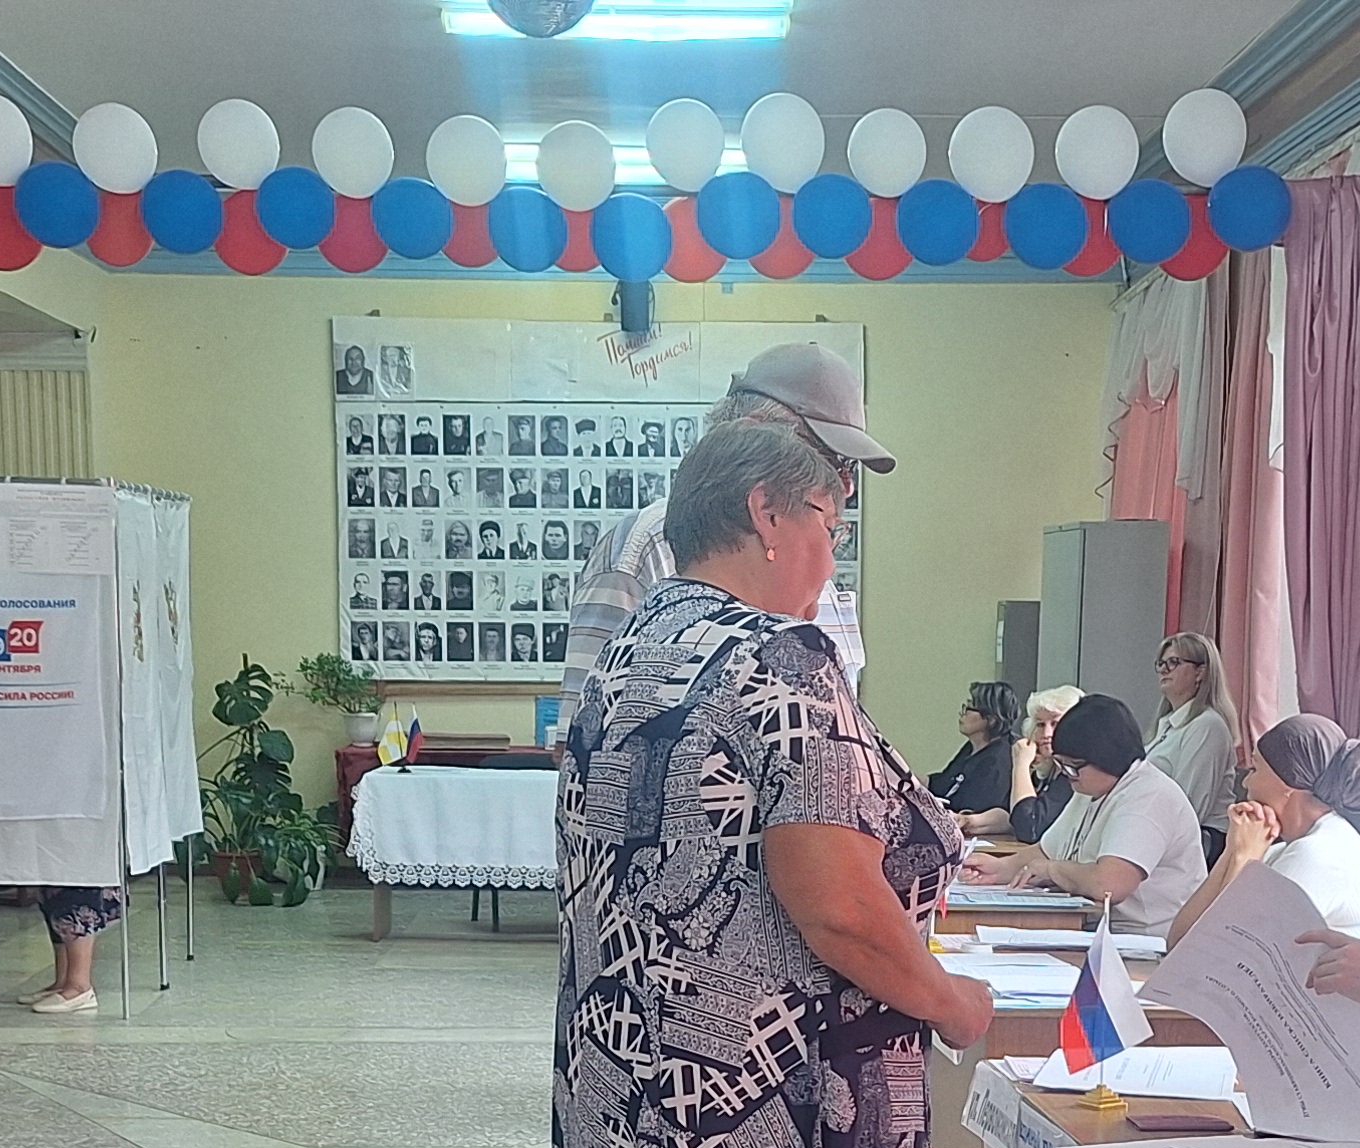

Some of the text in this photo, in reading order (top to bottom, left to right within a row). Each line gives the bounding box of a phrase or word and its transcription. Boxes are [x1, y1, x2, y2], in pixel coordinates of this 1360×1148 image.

[620, 331, 693, 388] Гордимся!
[9, 628, 37, 647] 20
[1236, 961, 1332, 1089] КНИГА СПИСКА ИЗБИРАТЕЛЕЙ
